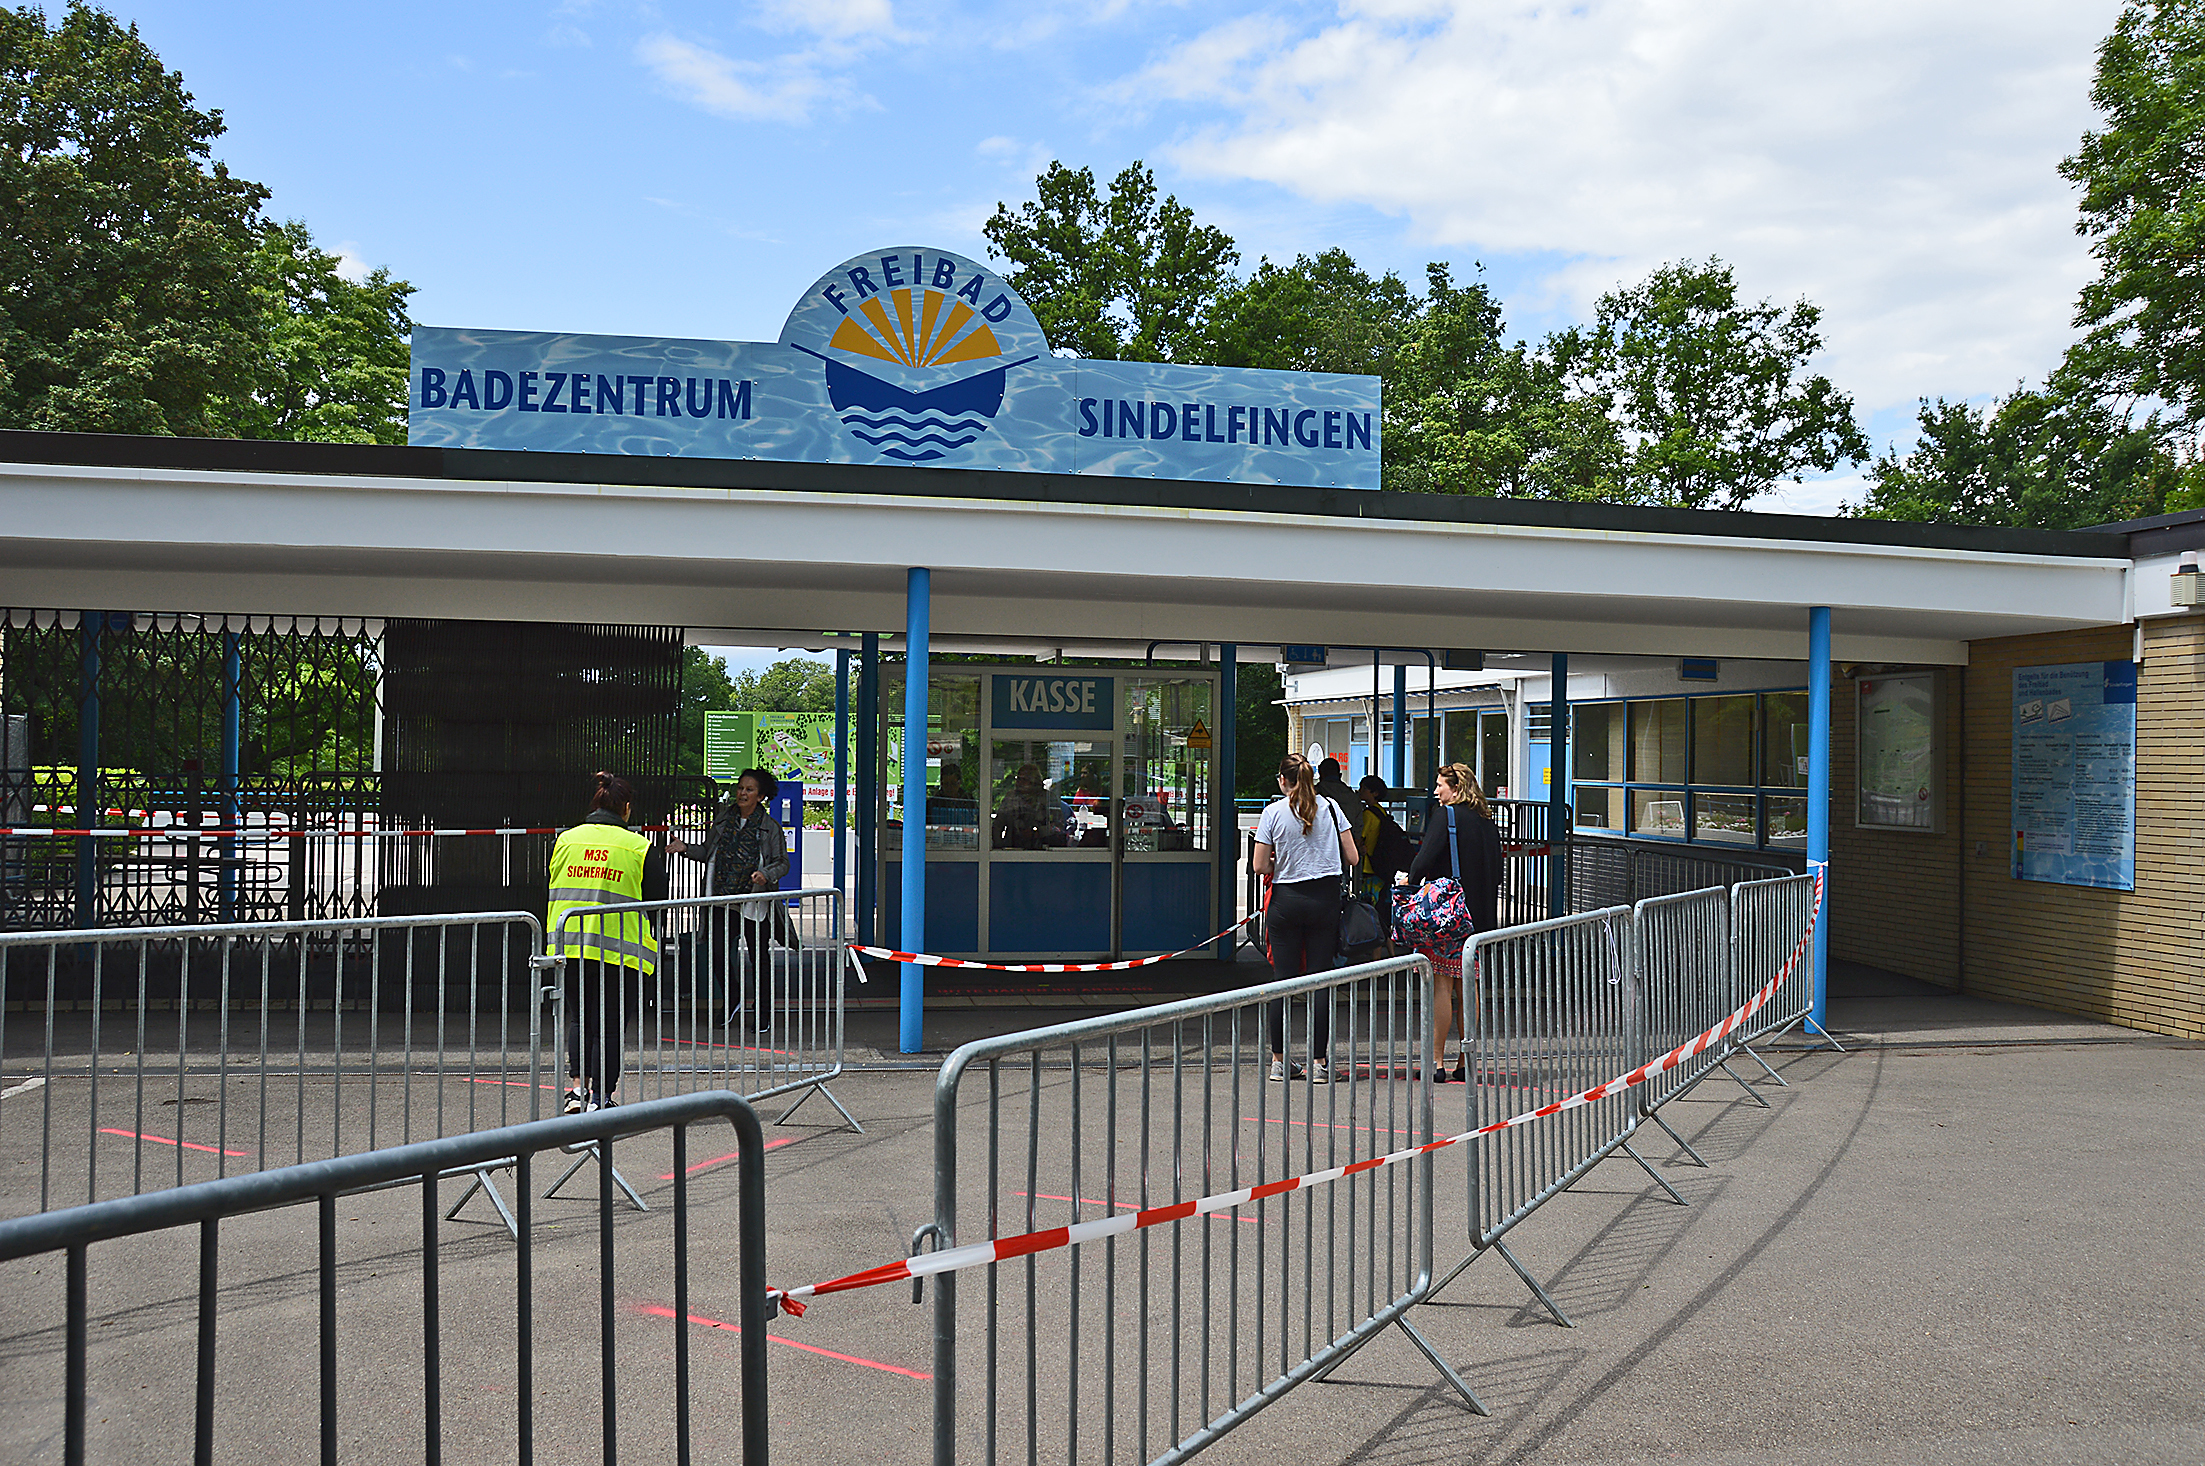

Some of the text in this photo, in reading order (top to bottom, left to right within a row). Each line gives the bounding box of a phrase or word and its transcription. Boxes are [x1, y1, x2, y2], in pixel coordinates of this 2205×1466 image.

[822, 254, 1012, 323] FREIBAD
[420, 367, 1371, 450] BADEZENTRUM SINDELFINGEN
[1010, 679, 1096, 713] KASSE
[808, 787, 829, 797] Anlage
[584, 849, 609, 861] M3S
[567, 865, 624, 882] SICHERHEIT
